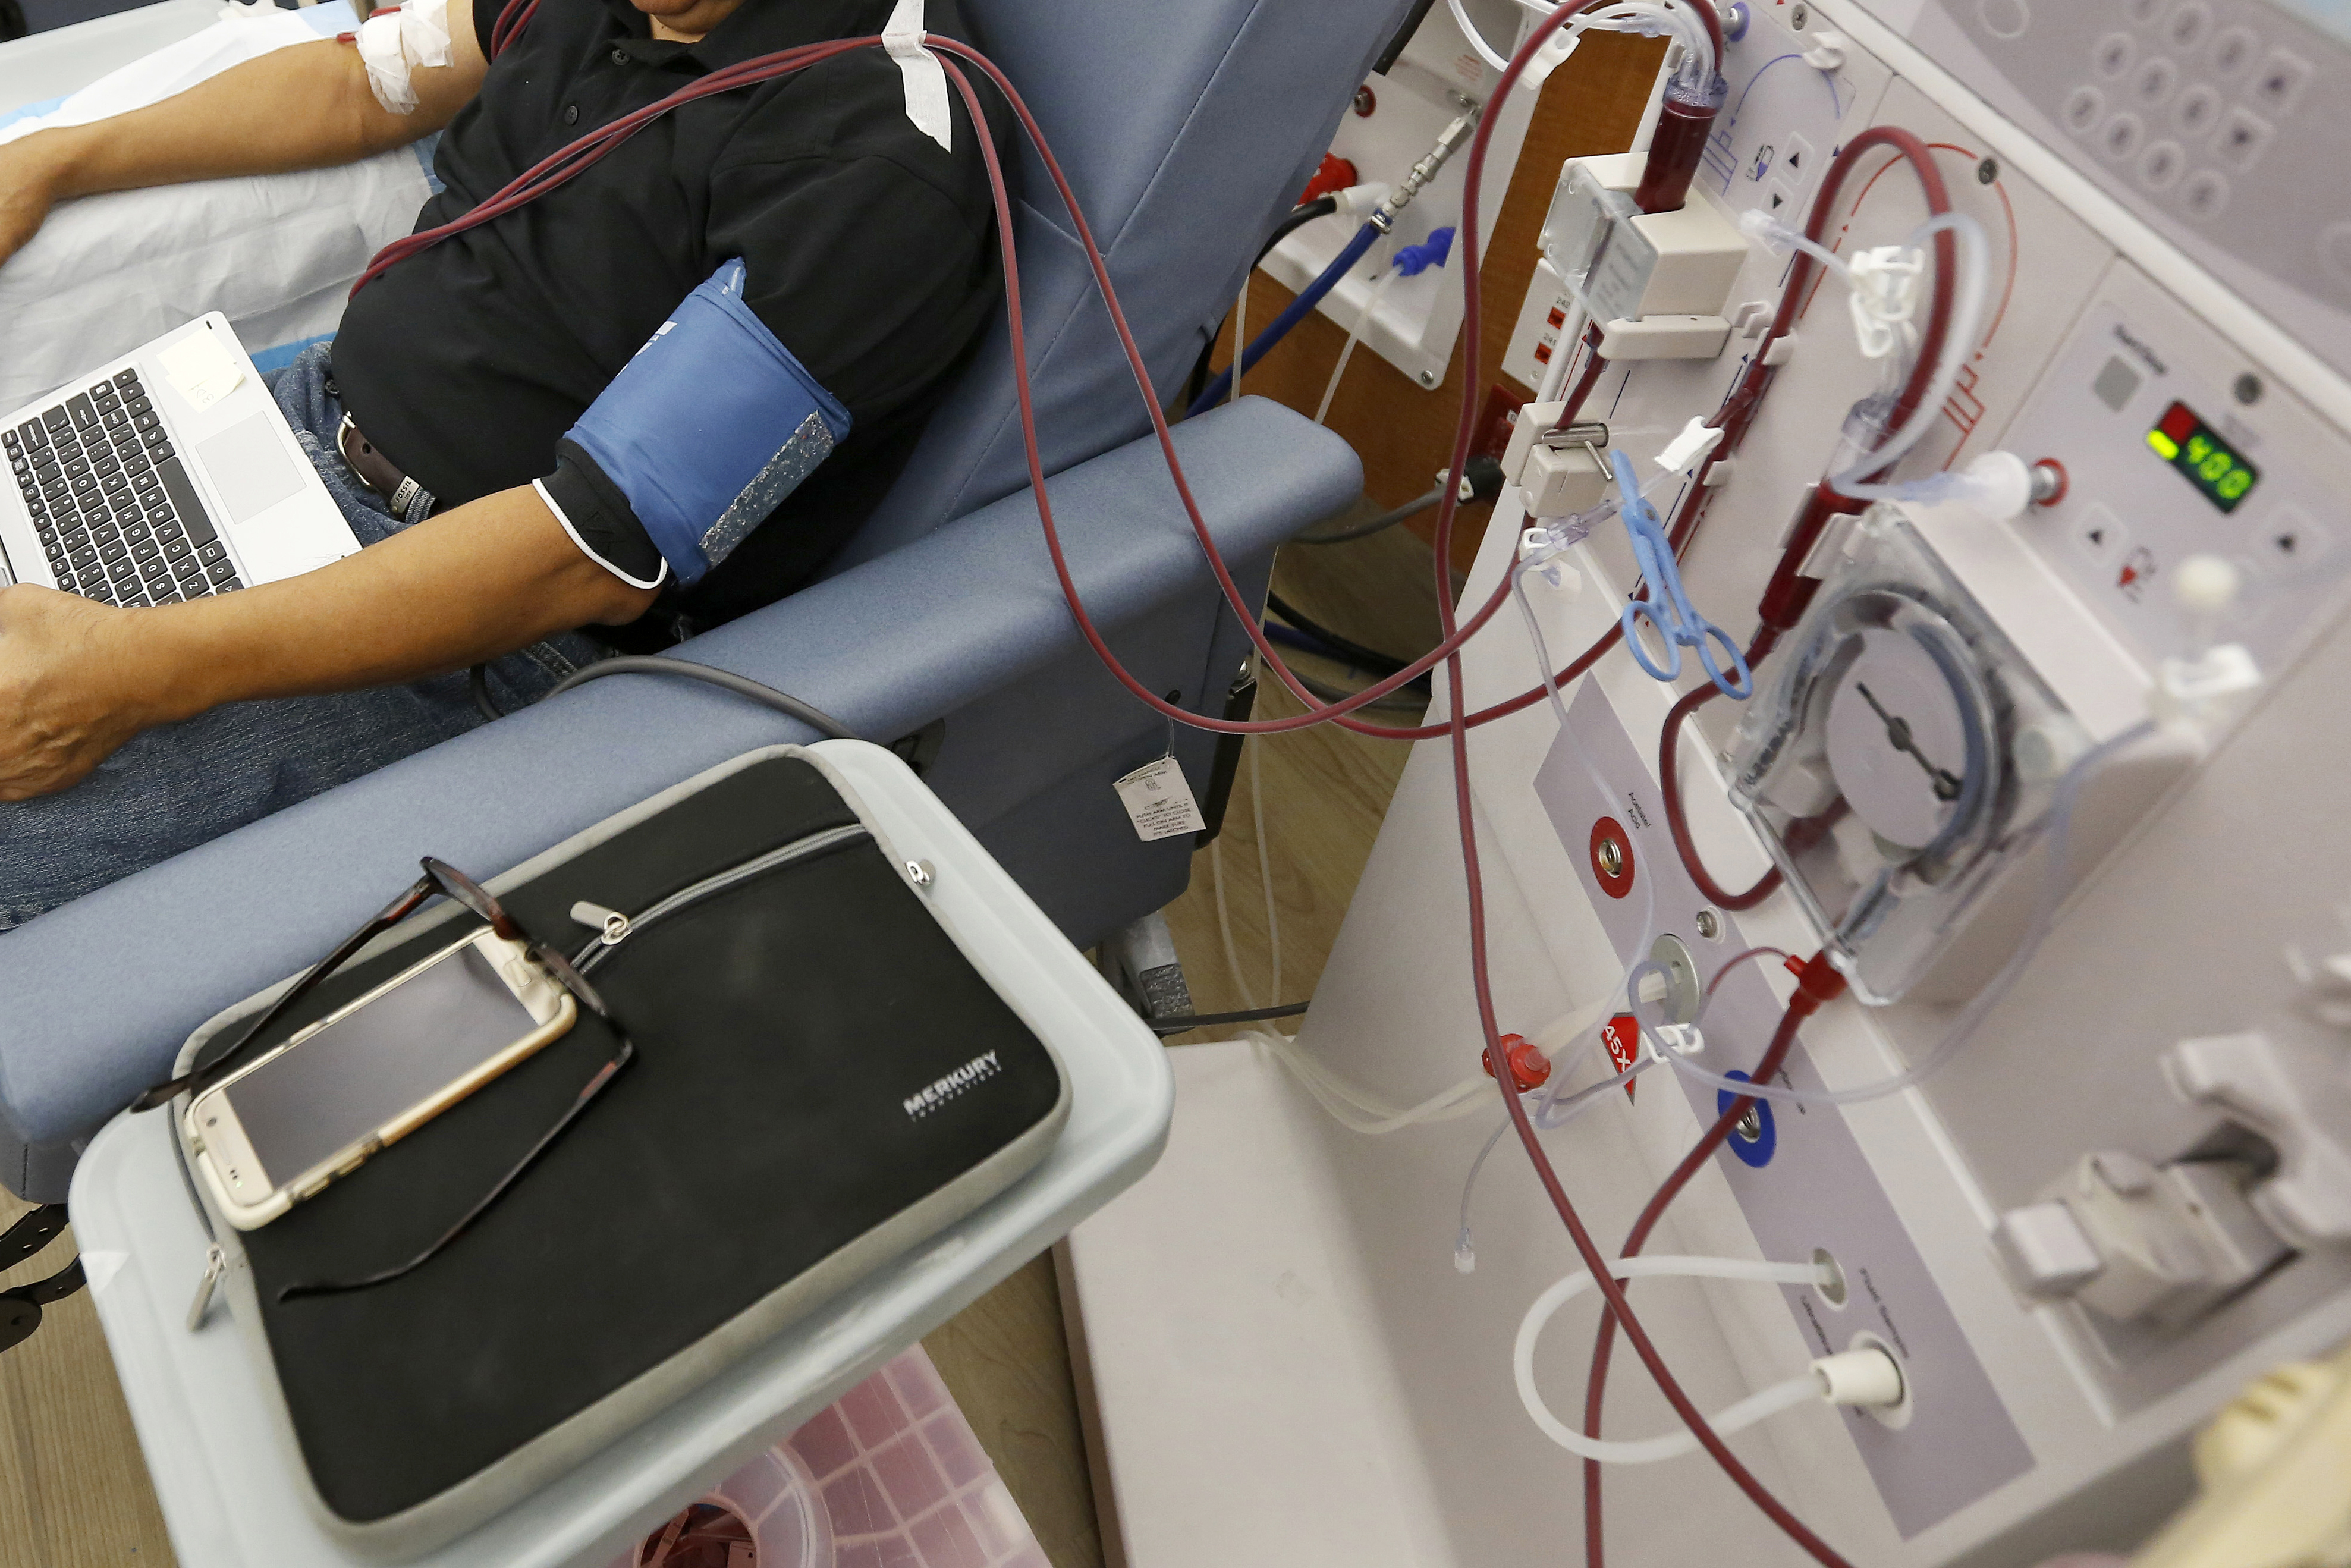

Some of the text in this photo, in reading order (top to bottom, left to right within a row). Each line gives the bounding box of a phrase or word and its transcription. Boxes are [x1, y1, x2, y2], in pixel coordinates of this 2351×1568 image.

[1557, 296, 1570, 308] 242
[1544, 332, 1557, 346] 241
[2187, 435, 2252, 499] 400
[1628, 808, 1640, 829] Acid
[1604, 1026, 1632, 1072] 45X
[903, 1049, 998, 1115] MERKURY
